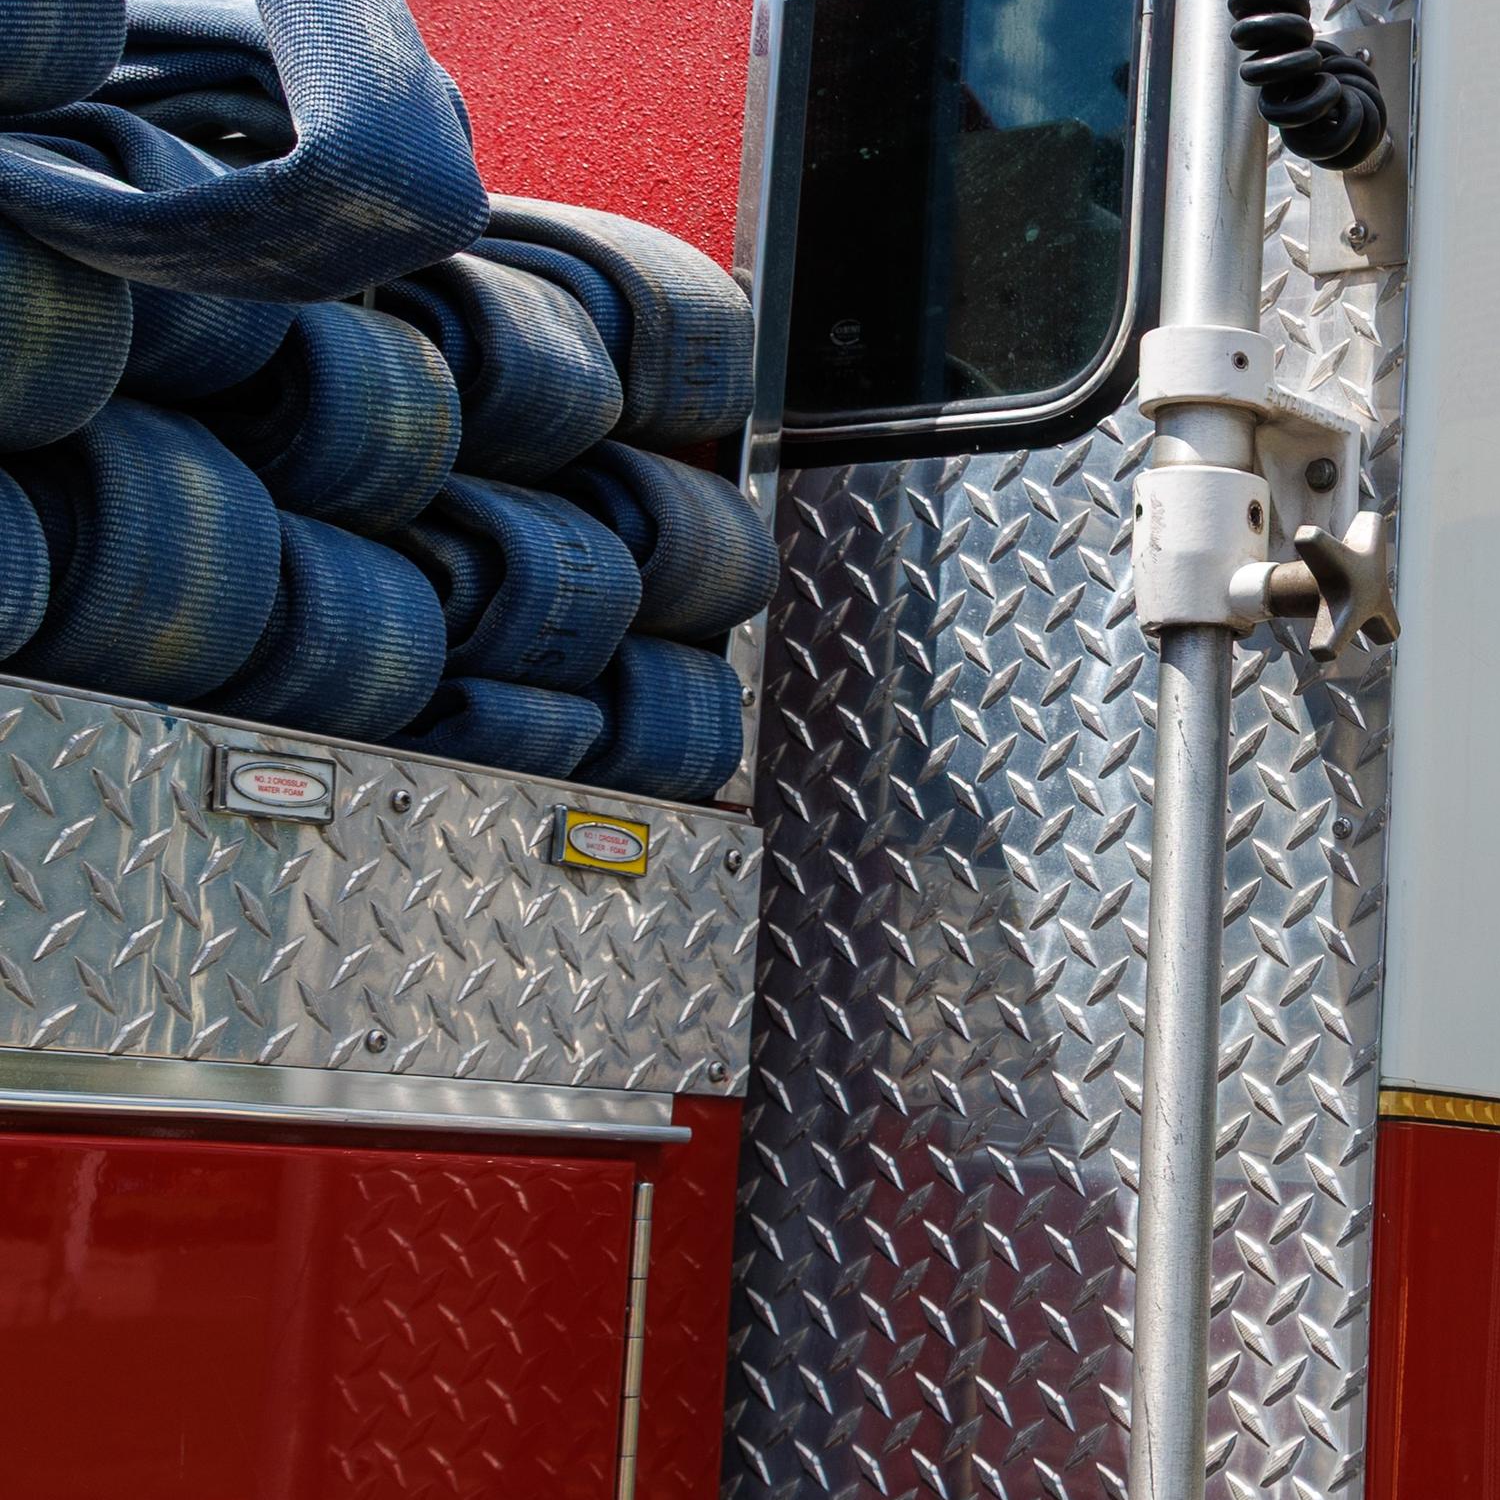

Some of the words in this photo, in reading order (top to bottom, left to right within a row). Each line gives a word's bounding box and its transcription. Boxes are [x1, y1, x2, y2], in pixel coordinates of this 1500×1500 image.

[272, 777, 308, 788] CROSSLAY
[258, 785, 280, 794] WATER
[599, 834, 629, 846] CROSSLAY
